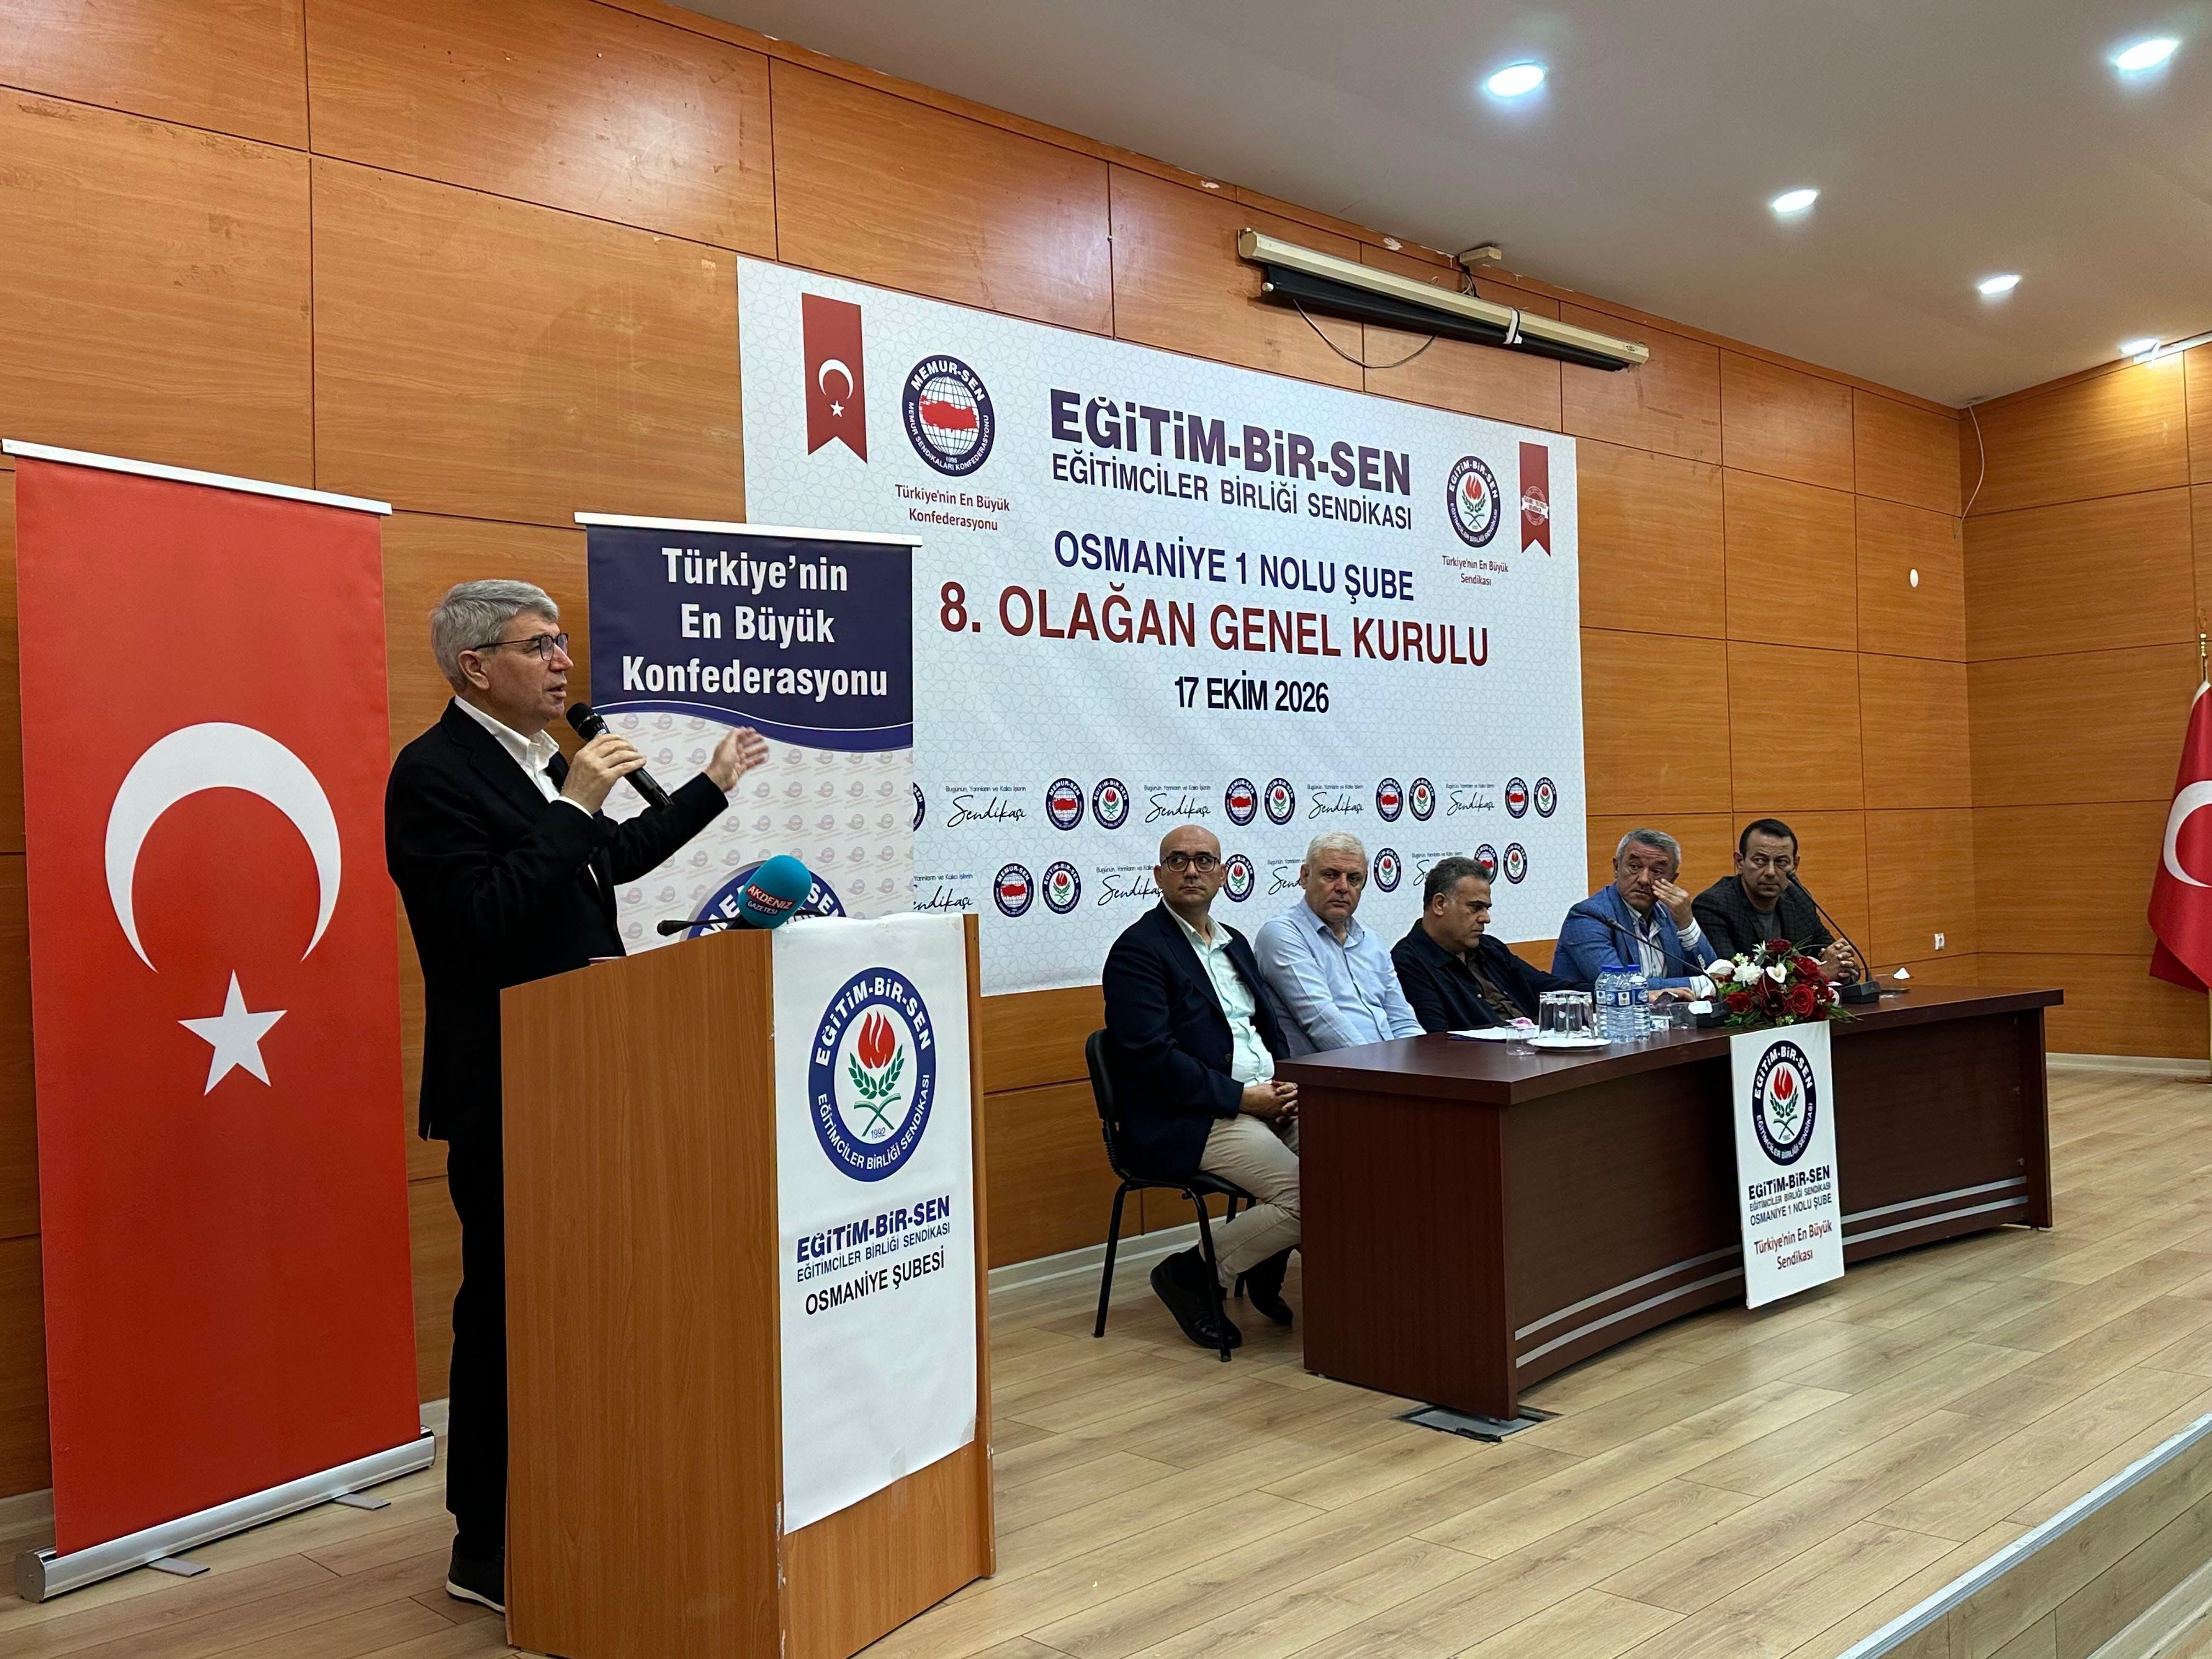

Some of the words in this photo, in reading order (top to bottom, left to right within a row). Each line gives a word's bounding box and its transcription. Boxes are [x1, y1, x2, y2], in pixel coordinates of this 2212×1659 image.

[911, 360, 985, 402] MEMUR-SEN
[908, 402, 918, 435] MEMUR
[956, 415, 989, 471] KONFEDERASYONU
[895, 484, 956, 504] Türkiye'nin
[960, 493, 973, 507] En
[977, 495, 1010, 512] Büyük
[1052, 447, 1209, 501] EĞİTİMCİLER
[1221, 476, 1297, 515] BİRLİĞİ
[1308, 494, 1412, 531] SENDİKASI
[909, 507, 998, 531] Konfederasyonu
[662, 547, 848, 595] Türkiye'nin
[1054, 530, 1226, 583] OSMANİYE
[1236, 552, 1246, 584] 1
[1261, 554, 1336, 594] NOLU
[1345, 564, 1414, 605] ŞUBE
[1479, 560, 1487, 570] En
[681, 603, 721, 639] En
[735, 606, 835, 649] Büyük
[940, 582, 981, 633] 8.
[999, 582, 1195, 647] OLAĞAN
[1210, 604, 1341, 657] GENEL
[1353, 617, 1488, 667] KURULU
[622, 655, 888, 702] Konfederasyonu
[1174, 676, 1199, 708] 17
[1207, 669, 1268, 710] EKİM
[1275, 680, 1329, 713] 2026
[818, 1093, 864, 1169] EĞİTİMCİLER
[866, 1146, 901, 1170] BİRLİĞİ
[900, 1074, 929, 1150] SENDİKASI
[871, 1127, 886, 1139] 1992
[1750, 1206, 1786, 1226] OSMANİYE
[1788, 1205, 1792, 1215] 1
[1793, 1199, 1812, 1214] NOLU
[1813, 1193, 1832, 1210] ŞUBE
[797, 1250, 861, 1283] EĞİTİMCİLER
[866, 1234, 899, 1260] BİRLİĞİ
[903, 1222, 950, 1247] SENDİKASI
[1754, 1231, 1796, 1255] Türkiye'nin
[1797, 1227, 1807, 1241] En
[1809, 1220, 1832, 1238] Büyük
[1777, 1249, 1813, 1270] Sendikası
[806, 1269, 888, 1315] OSMANİYE
[893, 1245, 945, 1289] ŞUBESİ
